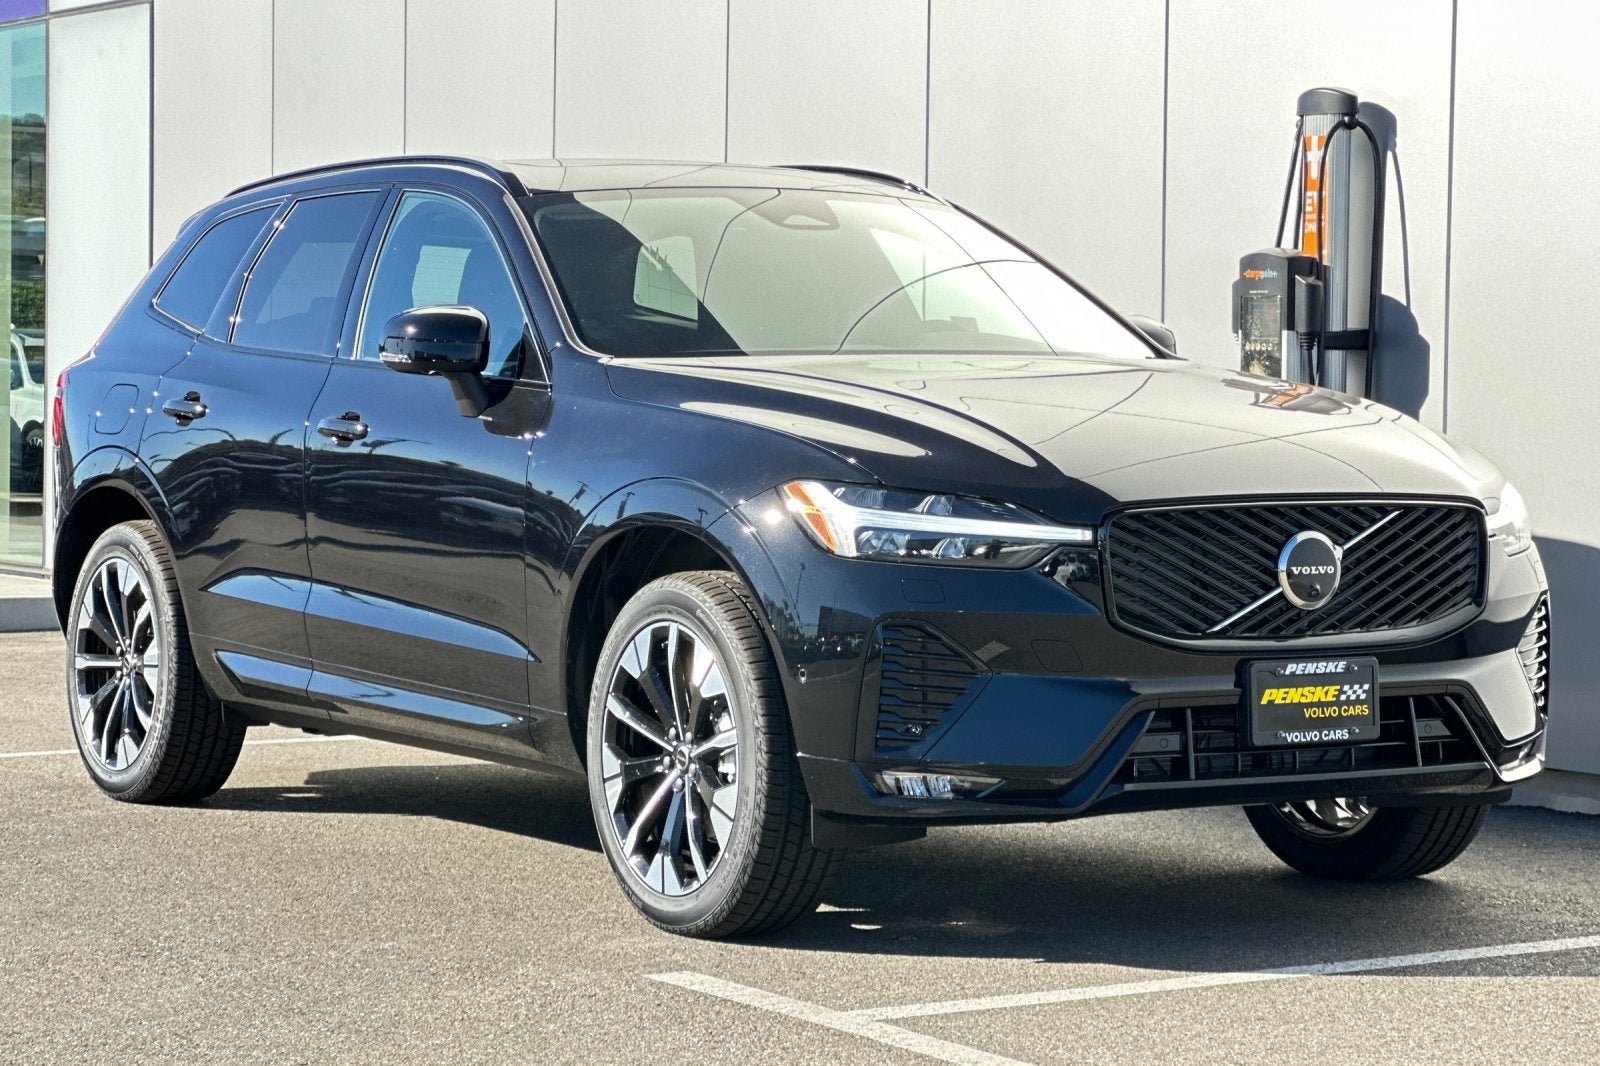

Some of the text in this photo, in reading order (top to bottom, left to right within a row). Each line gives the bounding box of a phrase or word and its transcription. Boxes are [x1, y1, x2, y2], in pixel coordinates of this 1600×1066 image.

[1290, 565, 1335, 575] VOLVO
[1285, 661, 1347, 675] PENSKE
[1260, 685, 1340, 705] PENSKE
[1304, 704, 1369, 719] VOLVO CARS
[1285, 728, 1349, 743] VOLVO CARS
